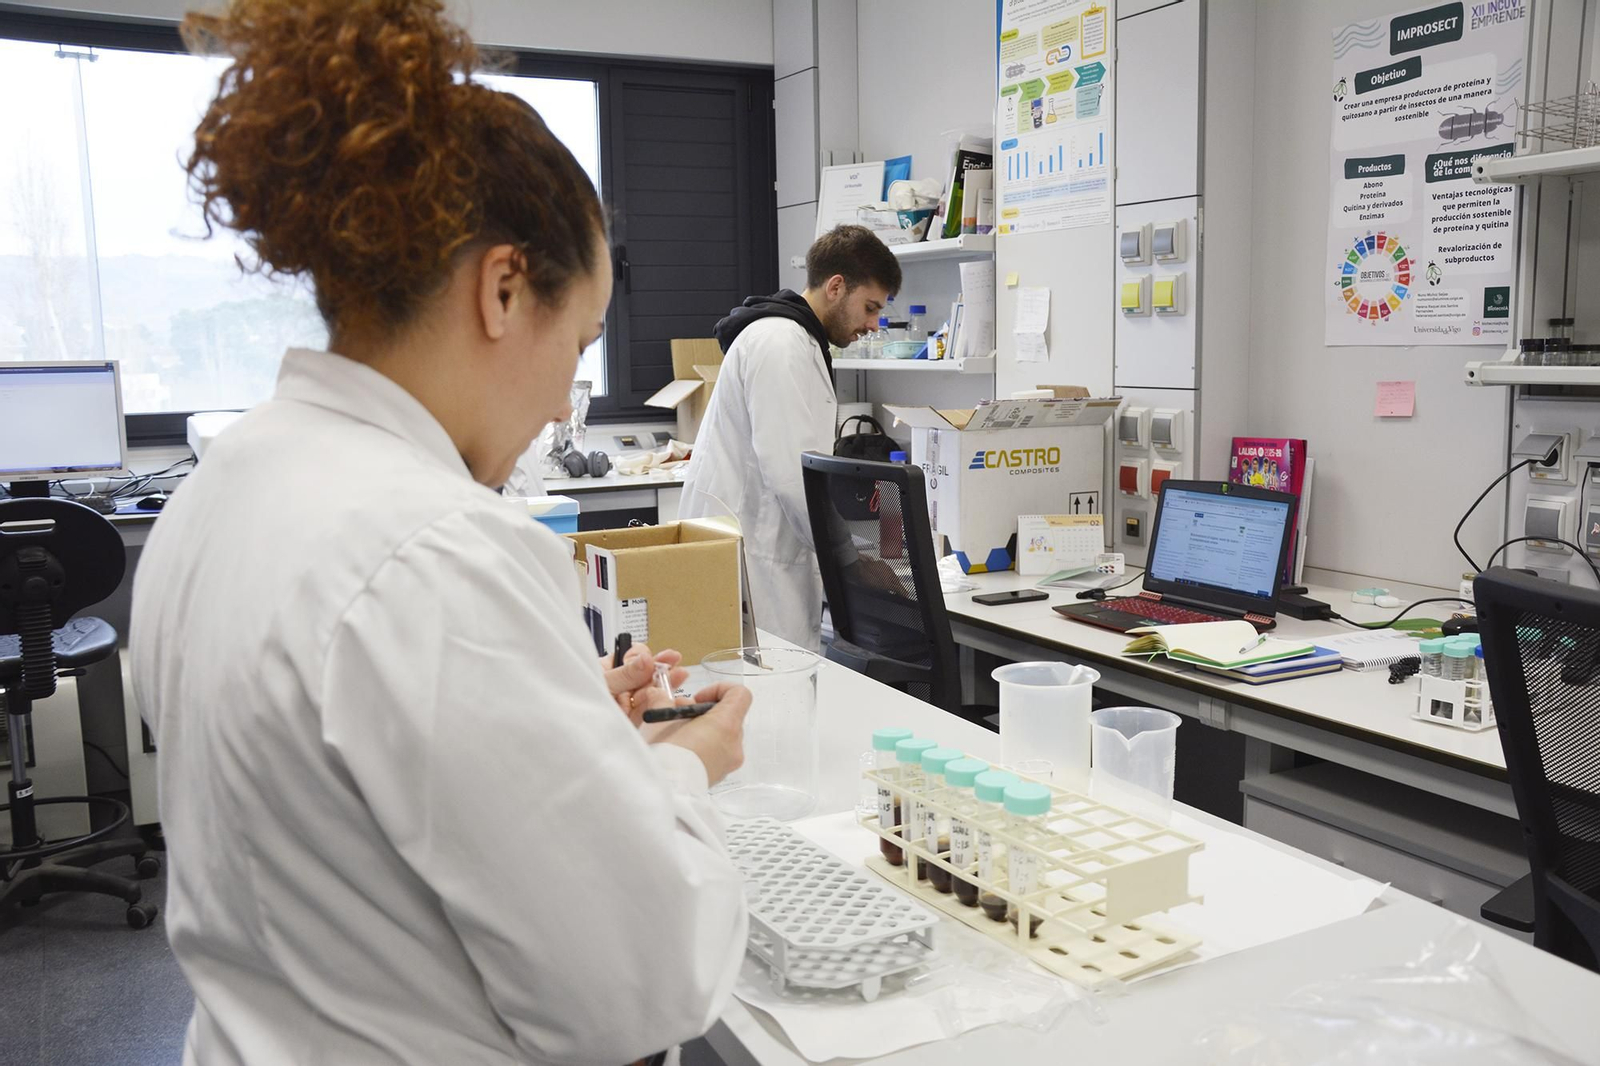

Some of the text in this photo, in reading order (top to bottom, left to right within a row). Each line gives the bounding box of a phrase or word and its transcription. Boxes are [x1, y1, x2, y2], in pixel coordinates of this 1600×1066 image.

[1471, 4, 1485, 18] XII
[1471, 6, 1526, 30] EMPRENDE
[1397, 16, 1458, 41] IMPROSECT
[1370, 68, 1407, 85] Objetivo
[1344, 102, 1360, 110] Crear
[1374, 95, 1402, 105] empresa
[1403, 86, 1441, 101] productora
[1443, 82, 1452, 92] de
[1453, 78, 1485, 92] proteína
[1486, 77, 1491, 85] y
[1341, 110, 1373, 122] quitosano
[1378, 105, 1398, 115] partir
[1398, 103, 1407, 111] de
[1408, 97, 1437, 109] insectos
[1437, 95, 1447, 104] de
[1448, 94, 1462, 102] una
[1463, 88, 1492, 99] manera
[1395, 110, 1429, 122] sostenible
[1358, 163, 1392, 173] Productos
[1433, 157, 1454, 170] ¿Qué
[1454, 157, 1468, 165] nos
[1433, 168, 1443, 177] de
[1445, 167, 1453, 176] la
[1363, 181, 1383, 189] Abono
[1360, 191, 1386, 200] Proteína
[1432, 185, 1513, 200] Ventajas tecnológicas
[1343, 204, 1366, 212] Quitina
[1372, 199, 1403, 209] derivados
[1442, 198, 1500, 212] que permiten la
[1359, 212, 1385, 220] Enzimas
[1431, 208, 1512, 224] producción sostenible
[1443, 223, 1474, 234] proteína
[1481, 220, 1509, 231] quitina
[1438, 241, 1502, 253] Revalorización de
[1444, 254, 1495, 264] subproductos
[1360, 270, 1385, 279] OBJETIVOS
[985, 447, 1060, 469] CASTRO
[1238, 447, 1257, 456] LALIGA
[1009, 467, 1060, 475] COMPOSITES
